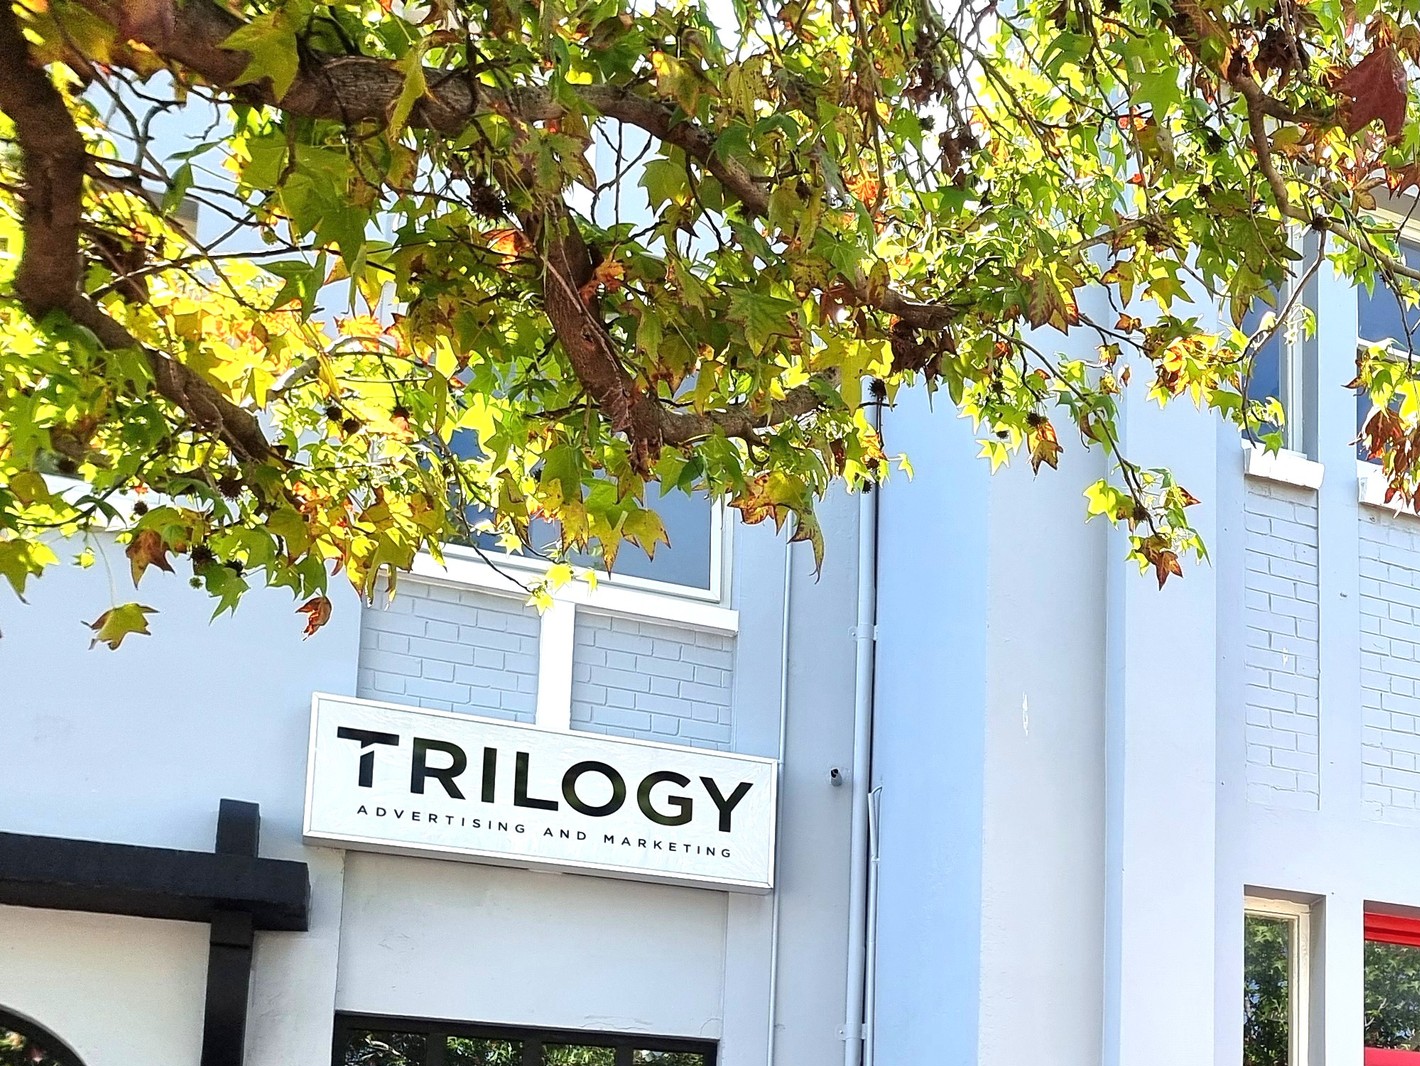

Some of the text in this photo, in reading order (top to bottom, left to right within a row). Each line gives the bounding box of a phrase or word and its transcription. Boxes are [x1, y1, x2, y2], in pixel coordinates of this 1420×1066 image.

[336, 725, 754, 833] TRILOGY
[357, 804, 732, 859] ADVERTISING AND MARKETING
